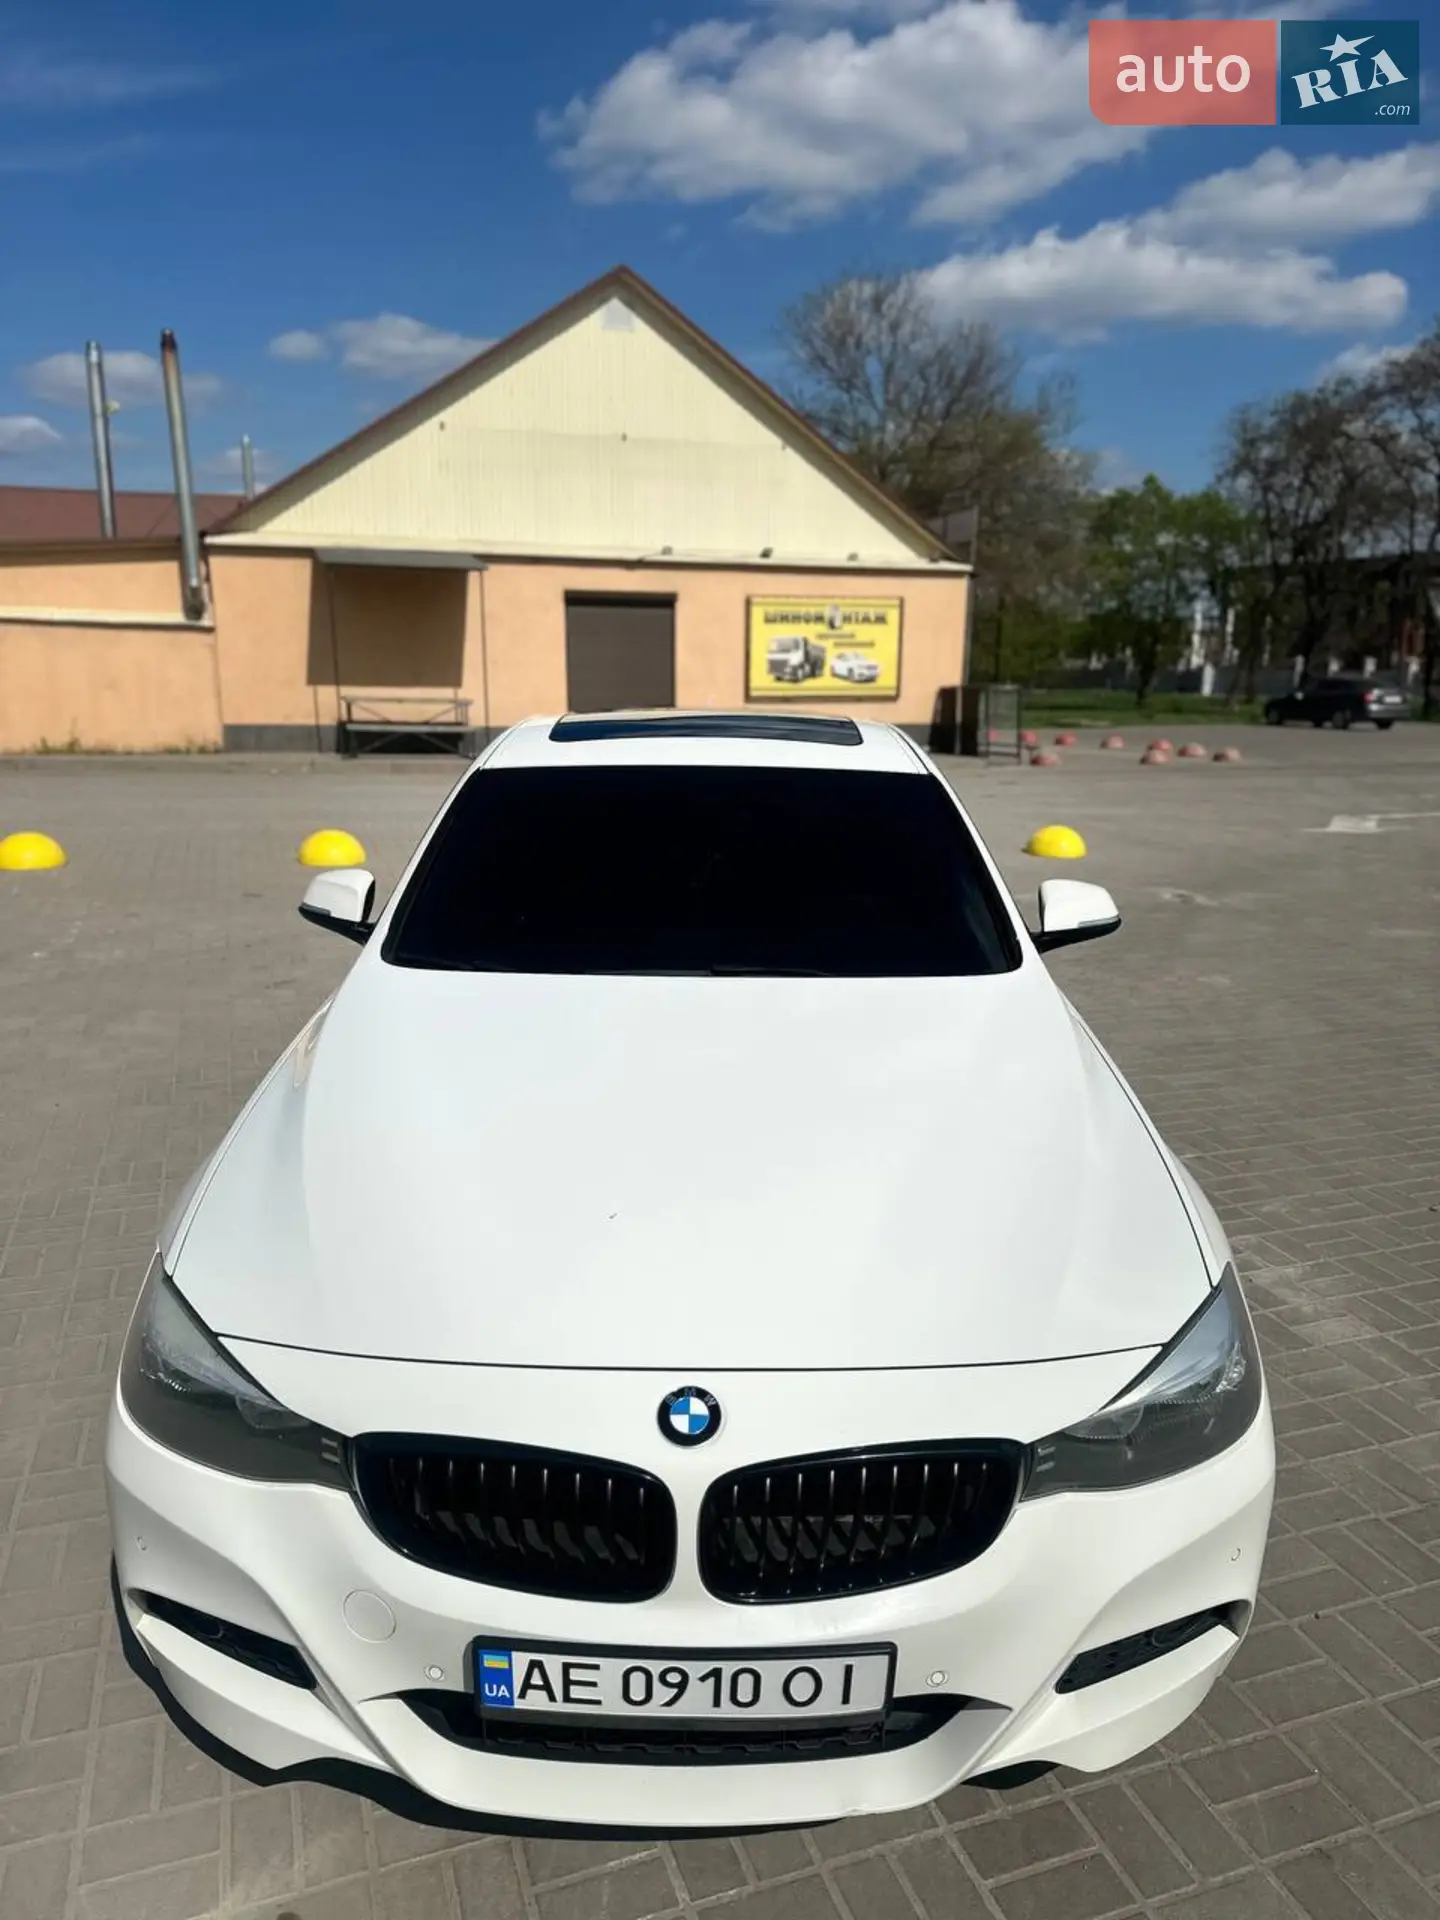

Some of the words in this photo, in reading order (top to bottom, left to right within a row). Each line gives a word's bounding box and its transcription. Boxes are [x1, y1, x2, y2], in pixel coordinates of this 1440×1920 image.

[484, 1682, 511, 1699] UA
[517, 1658, 602, 1706] AE
[621, 1665, 762, 1708] 0910
